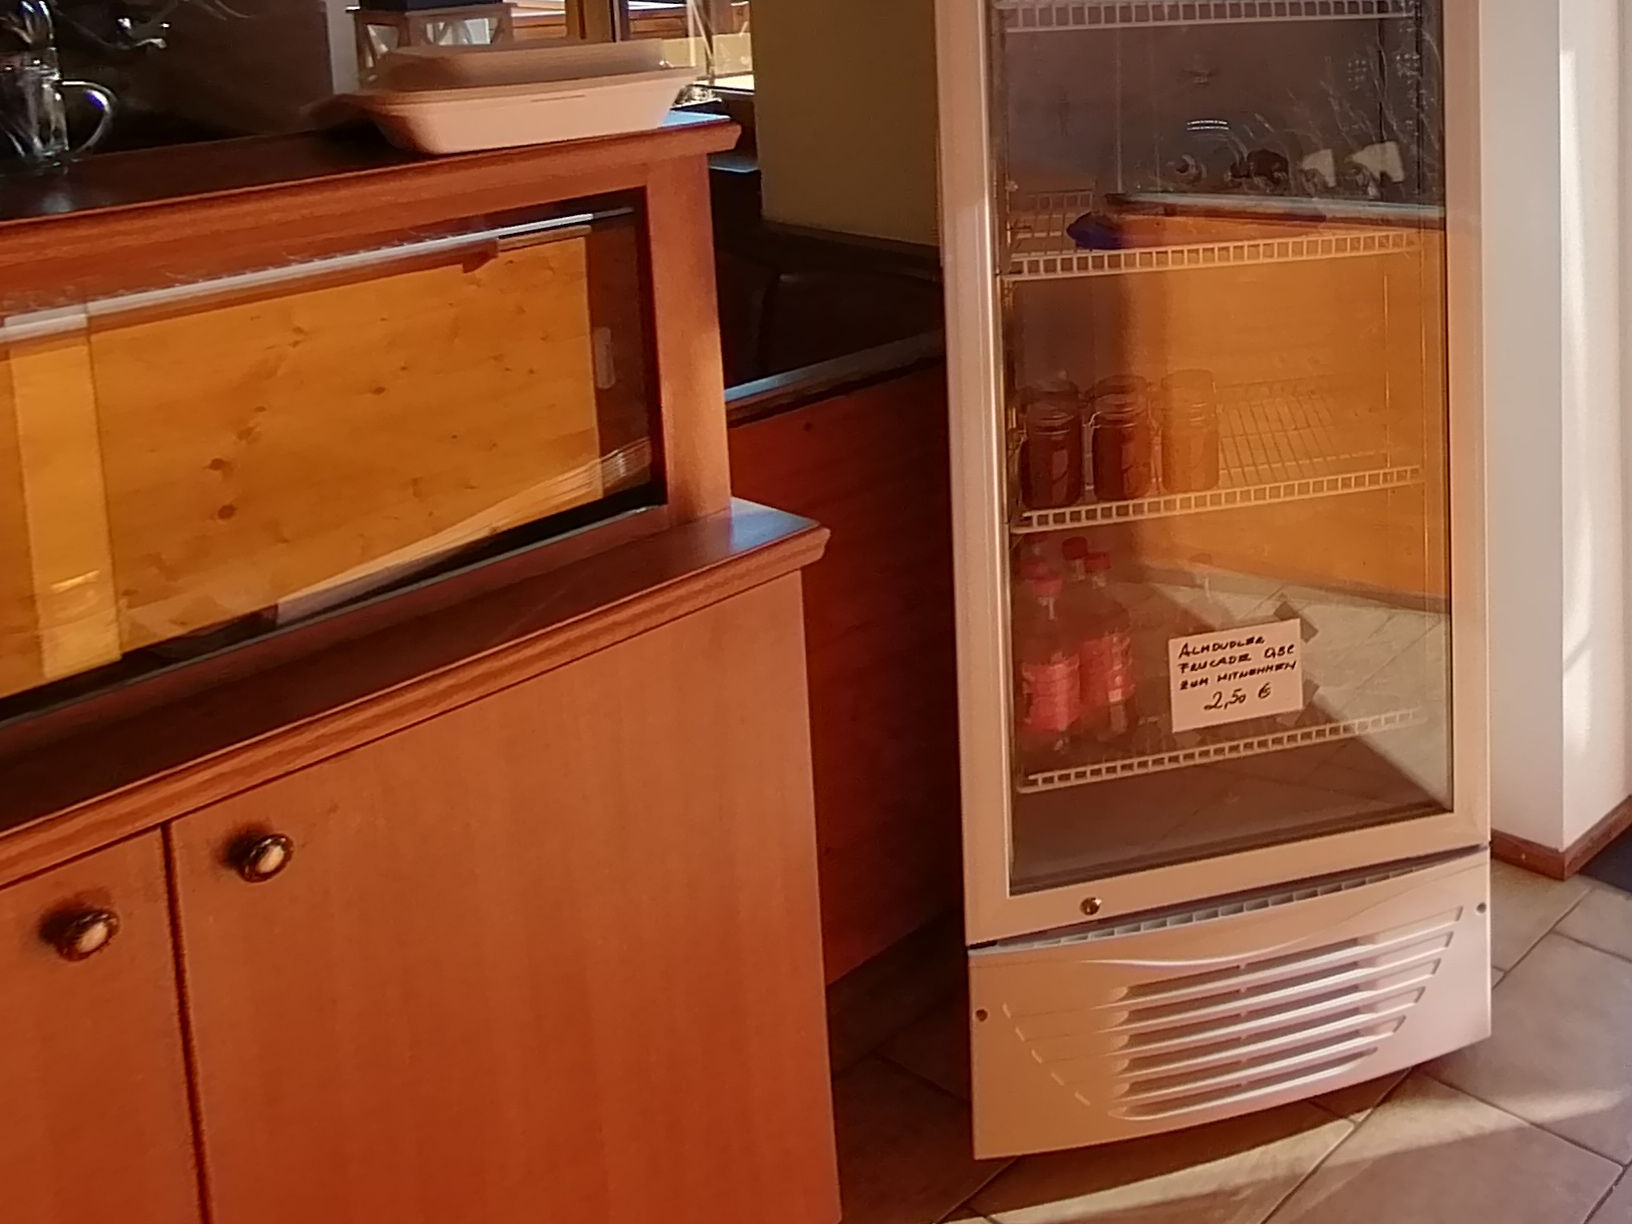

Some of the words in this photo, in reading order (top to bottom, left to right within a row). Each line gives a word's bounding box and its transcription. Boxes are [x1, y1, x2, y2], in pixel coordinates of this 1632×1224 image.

[1179, 677, 1209, 691] ZUM
[1217, 660, 1297, 683] MITNEHMEN
[1203, 688, 1247, 711] 2,50
[1258, 681, 1272, 699] €
